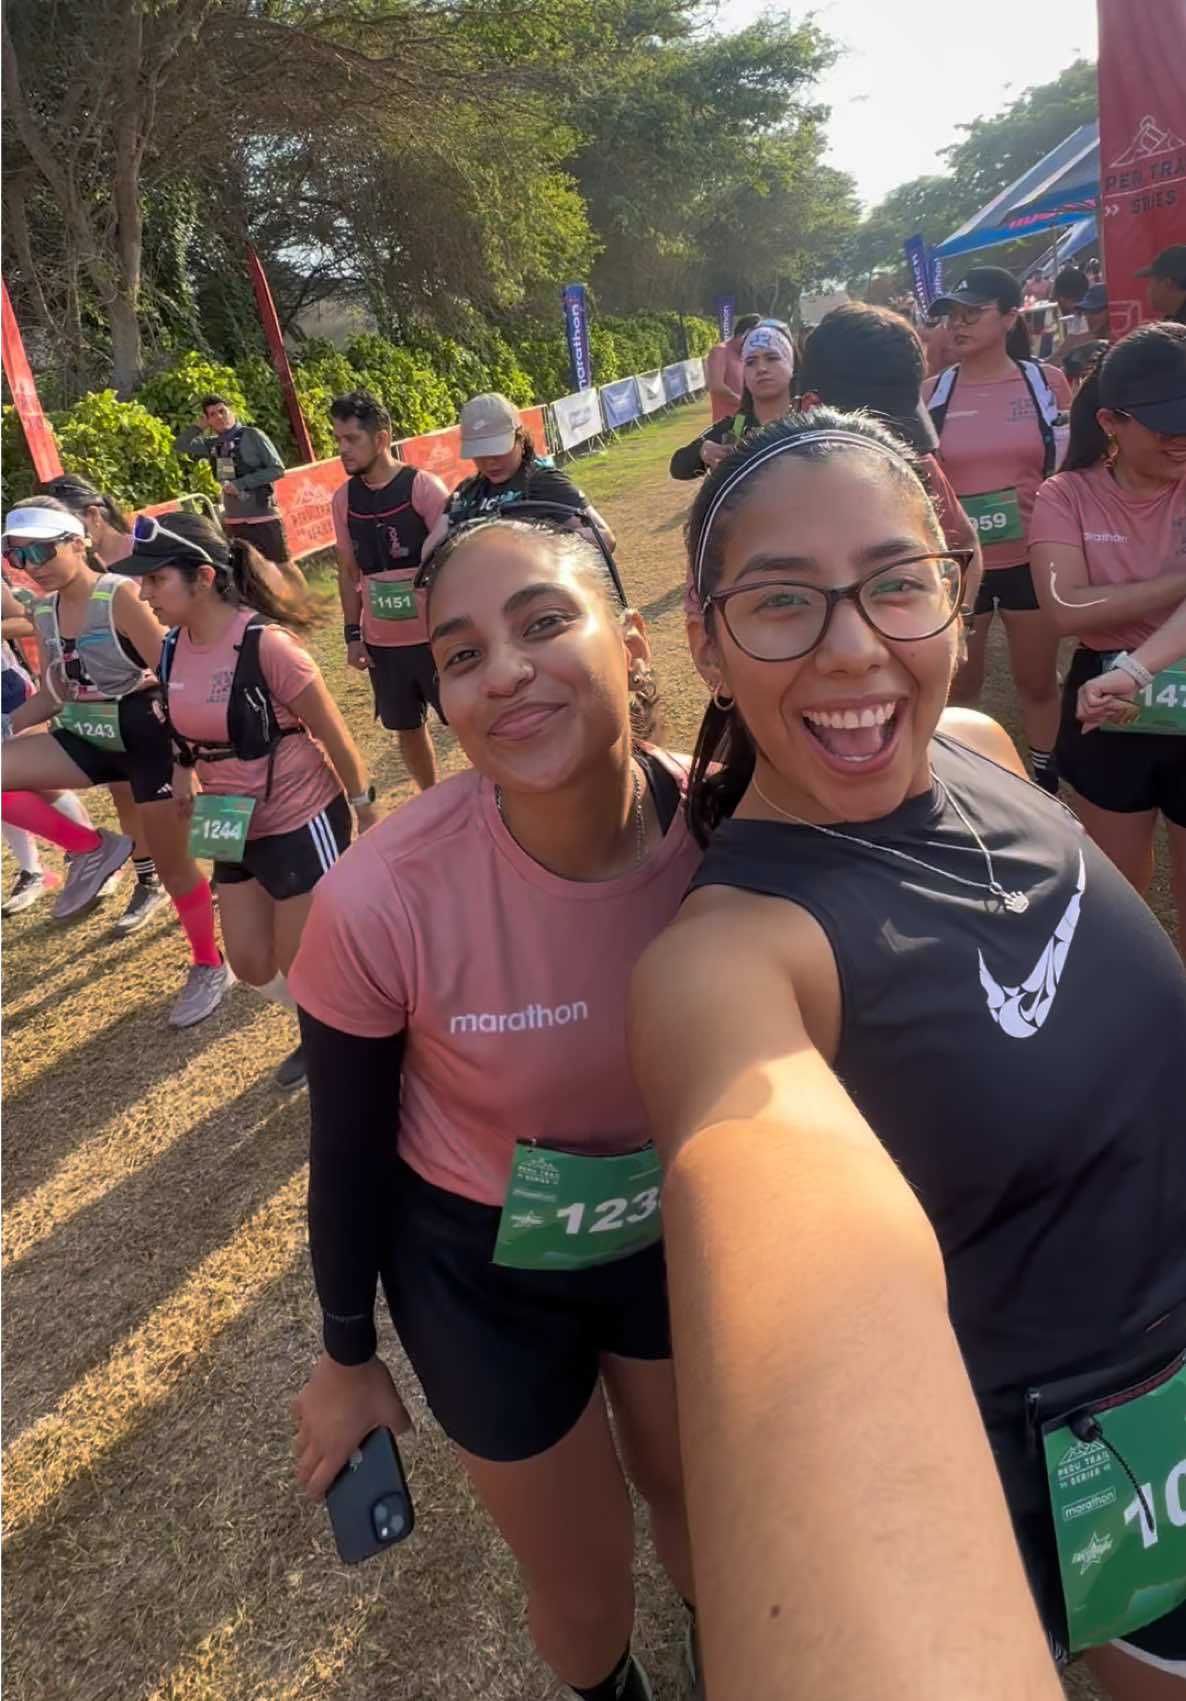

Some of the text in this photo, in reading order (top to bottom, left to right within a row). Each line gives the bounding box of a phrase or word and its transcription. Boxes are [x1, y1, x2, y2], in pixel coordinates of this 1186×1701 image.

[74, 721, 116, 738] 1243
[202, 820, 243, 841] 1244
[450, 1000, 588, 1034] marathon
[556, 1187, 661, 1235] 123
[1065, 1491, 1114, 1518] marathon
